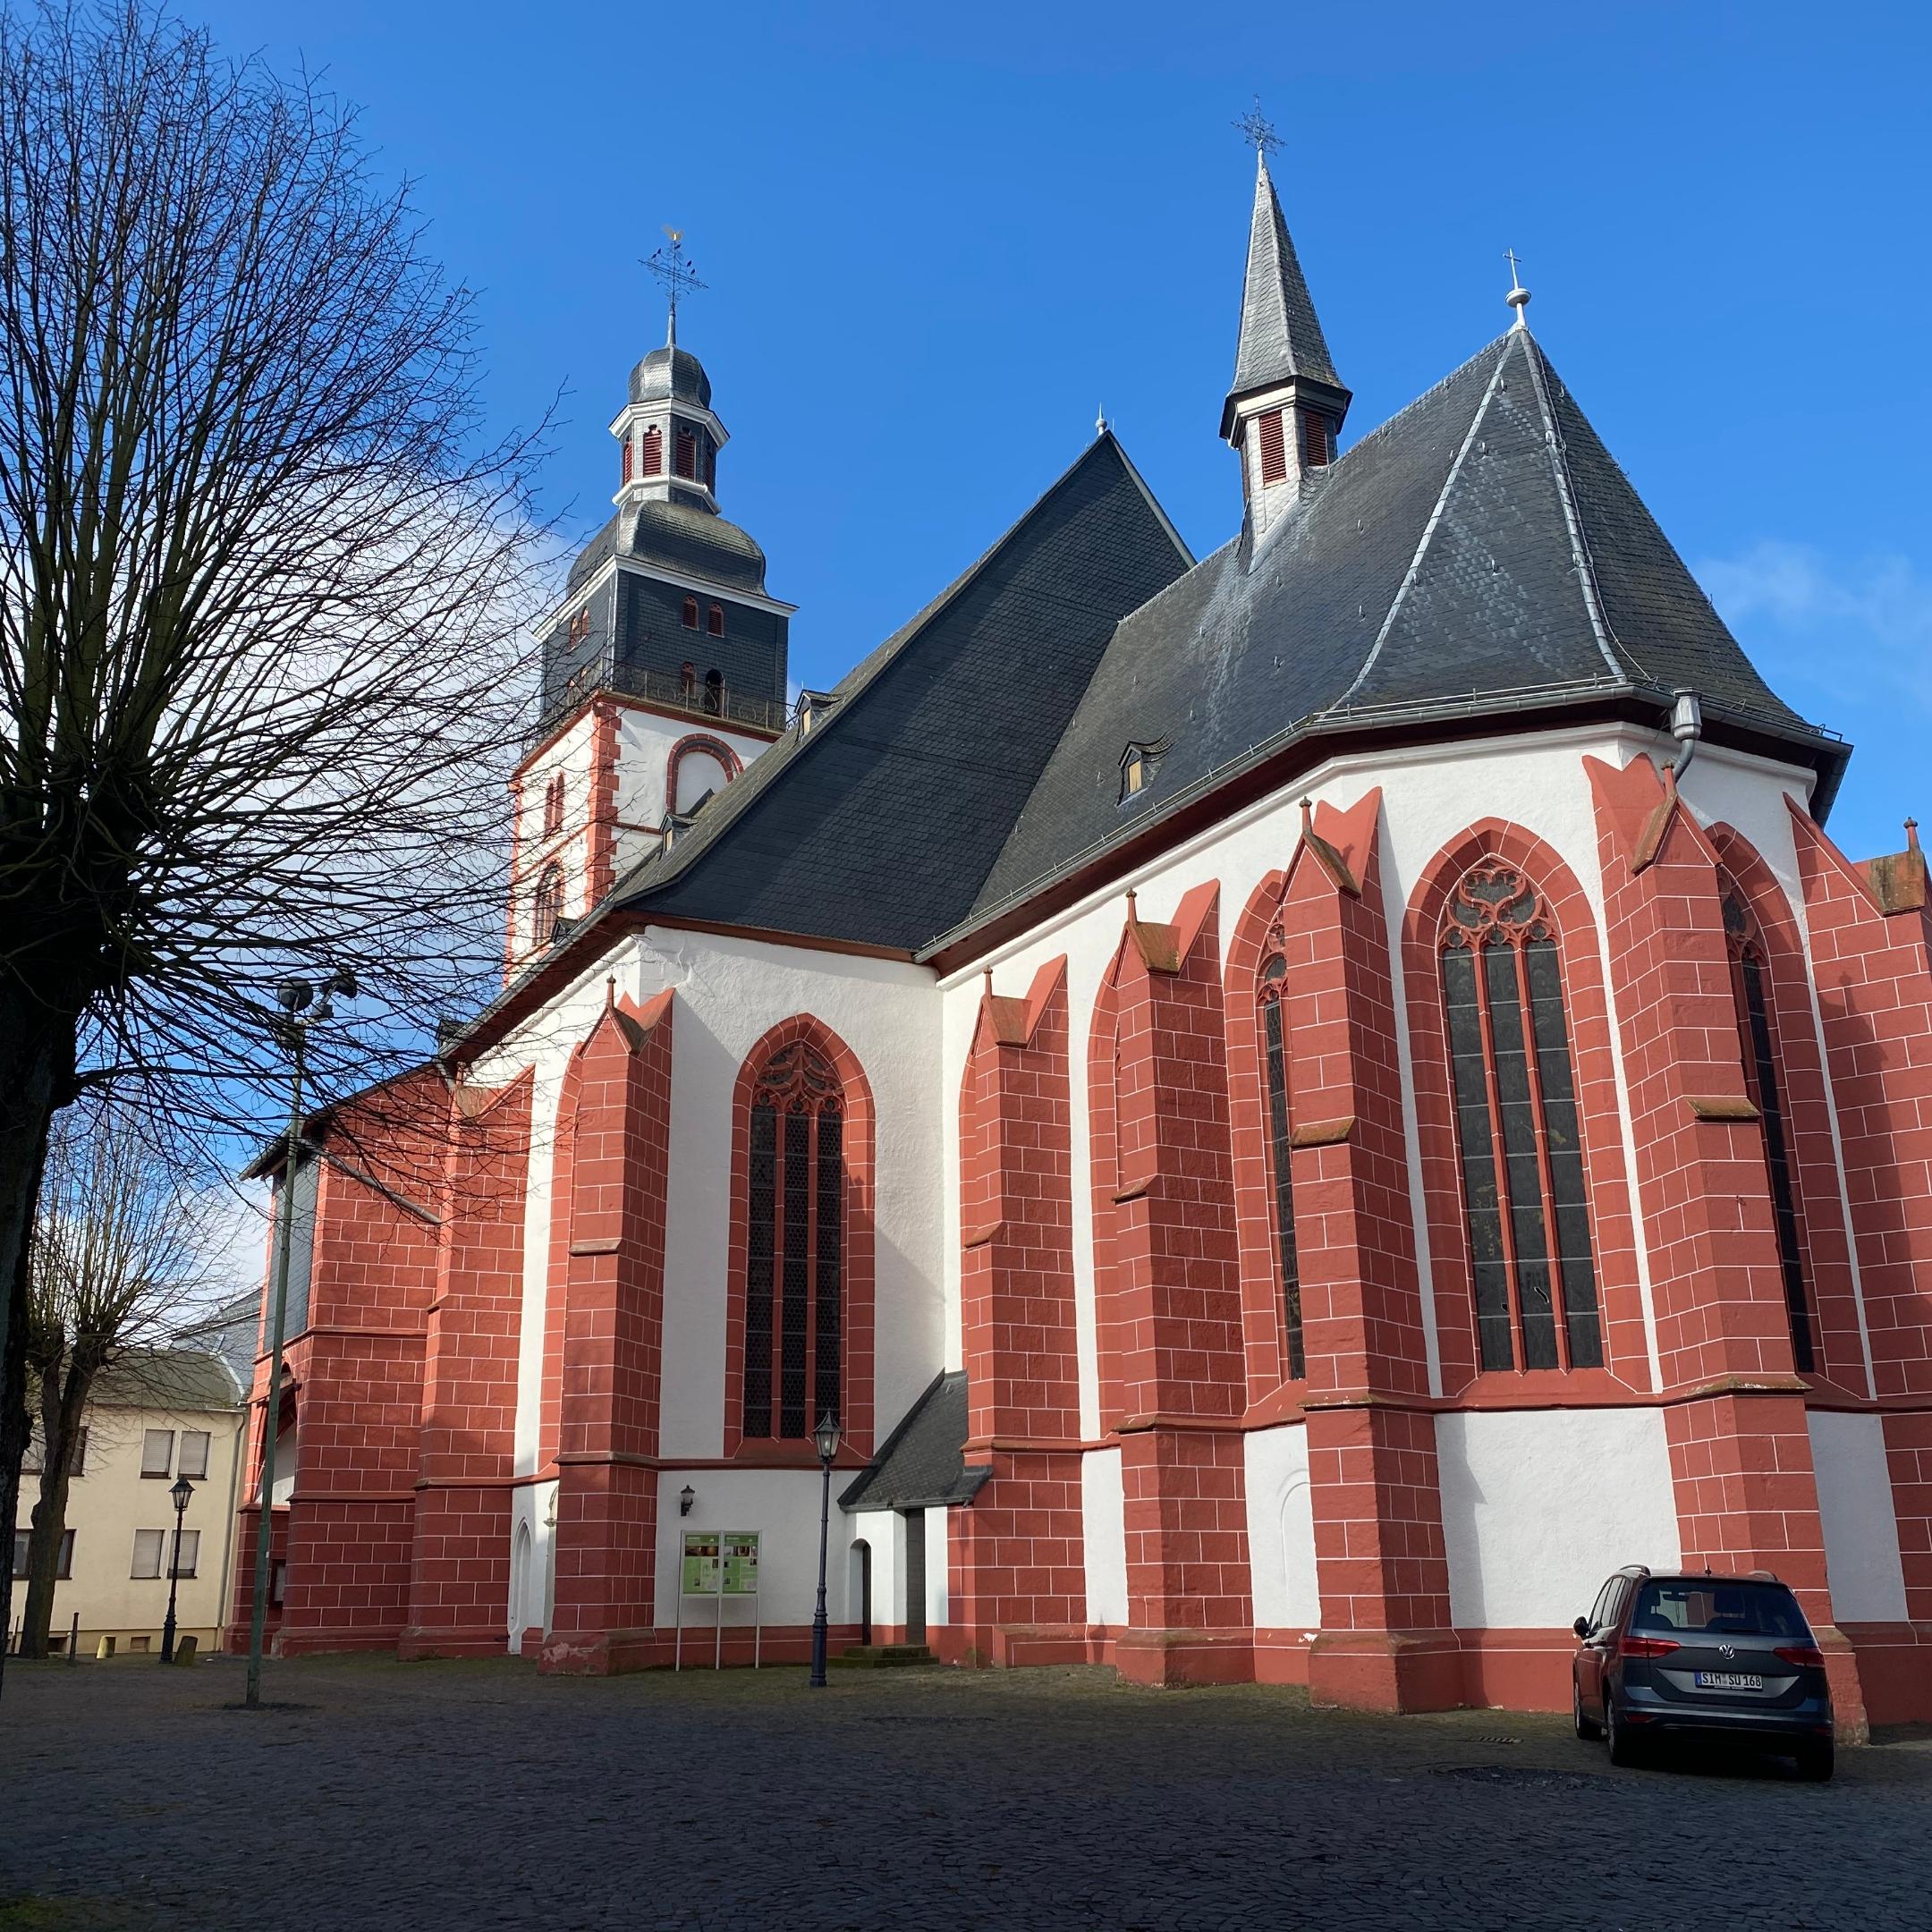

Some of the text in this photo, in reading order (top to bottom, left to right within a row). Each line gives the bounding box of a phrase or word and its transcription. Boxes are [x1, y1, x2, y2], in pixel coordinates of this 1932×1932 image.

[1702, 1673, 1761, 1687] SIM SU 168
